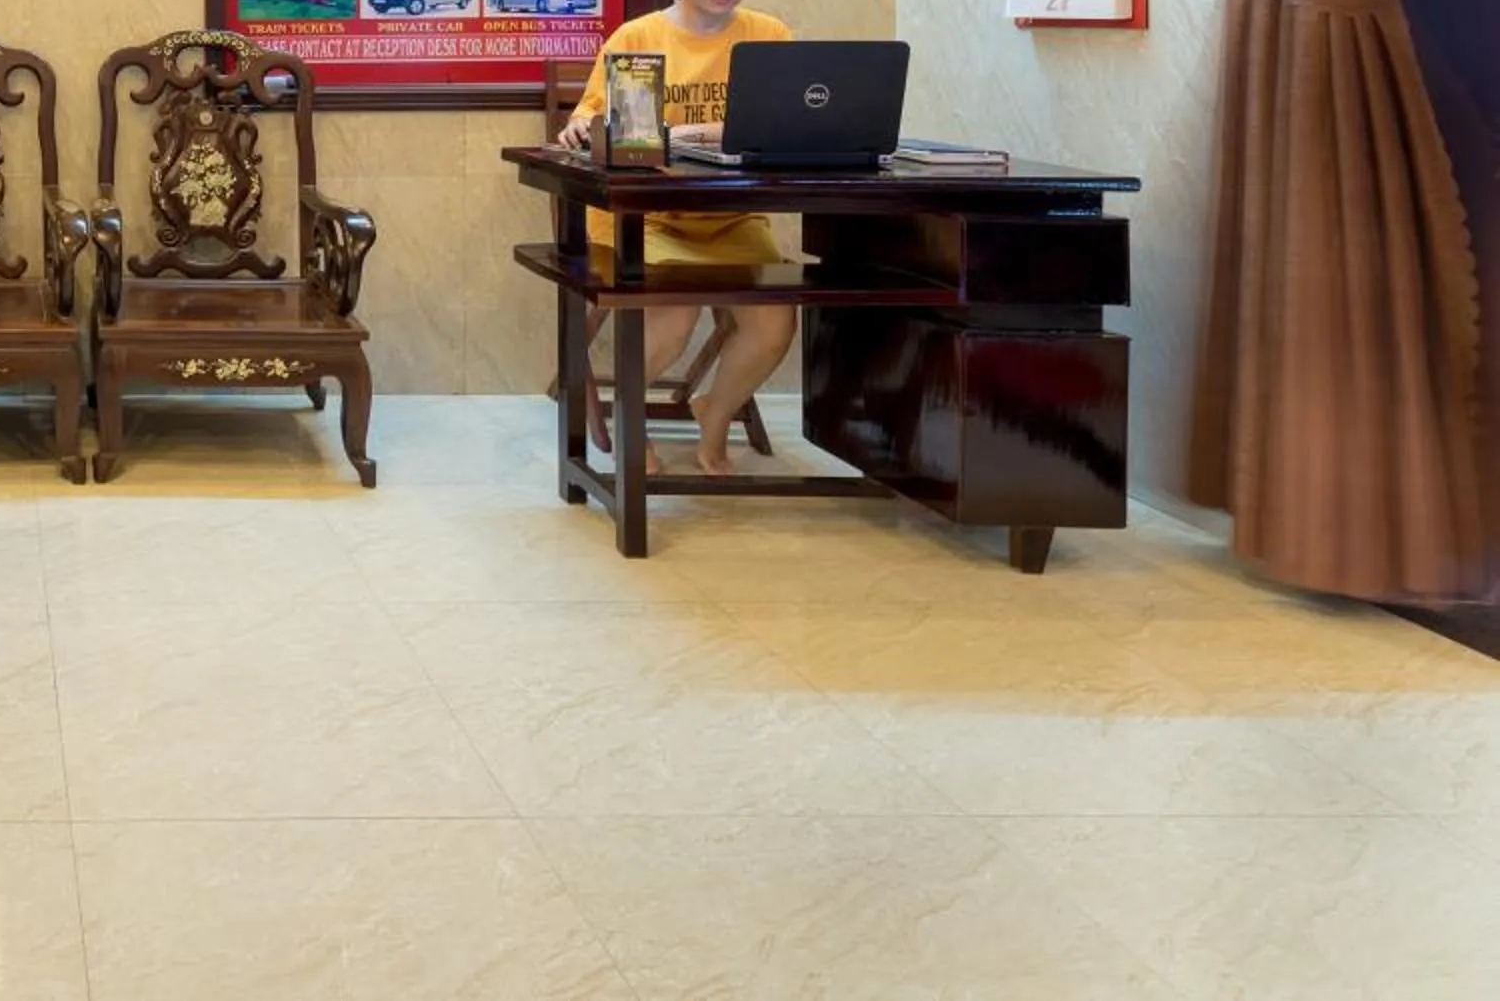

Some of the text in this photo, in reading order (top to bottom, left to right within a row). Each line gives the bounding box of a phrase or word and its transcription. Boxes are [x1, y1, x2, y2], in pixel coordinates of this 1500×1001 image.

[248, 22, 345, 34] TRAIN TICKETS
[377, 21, 463, 33] PRIVATE CAR
[483, 20, 605, 31] OPEN BUS TICKETS
[289, 38, 342, 58] CONTACT
[346, 38, 360, 57] AT
[363, 37, 425, 57] RECEPTION
[427, 37, 457, 56] DESK
[459, 37, 483, 56] FOR
[485, 37, 516, 56] MORE
[518, 36, 598, 56] INFORMATION
[684, 105, 708, 123] THE
